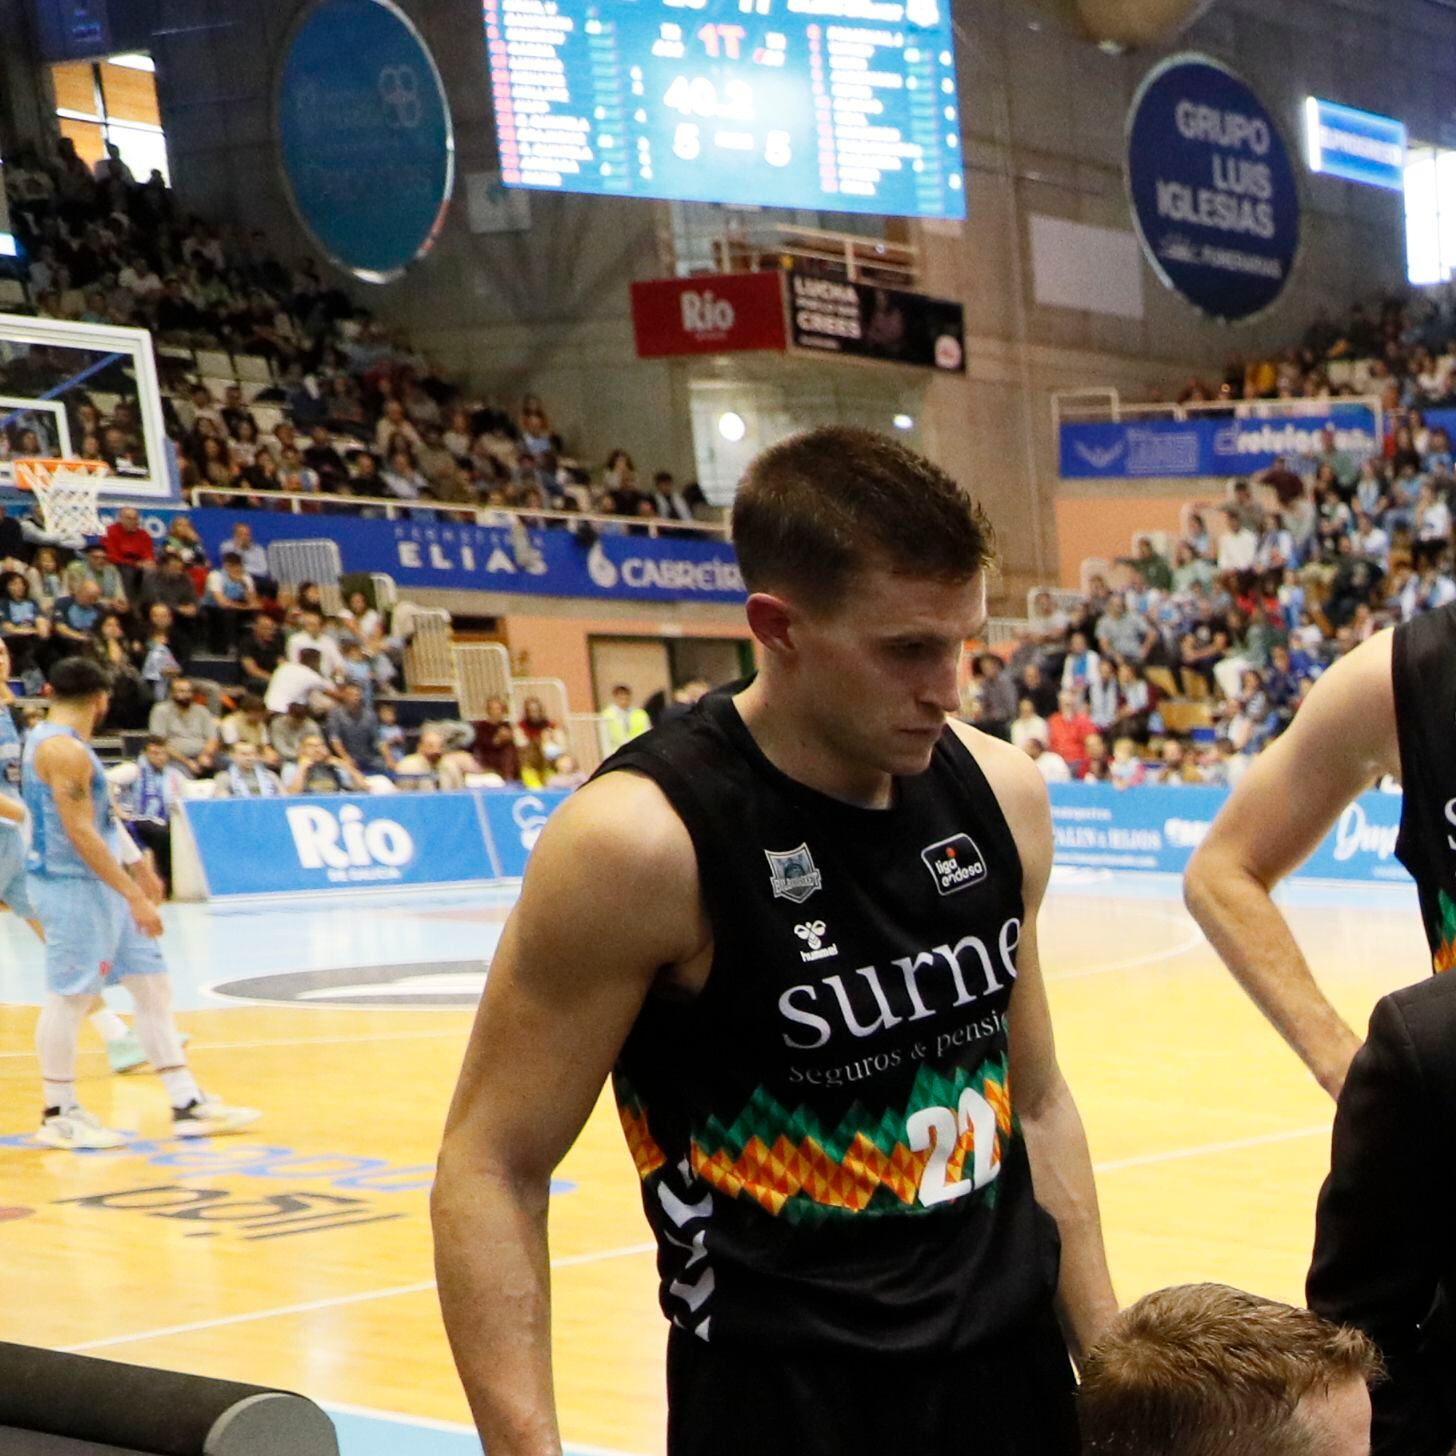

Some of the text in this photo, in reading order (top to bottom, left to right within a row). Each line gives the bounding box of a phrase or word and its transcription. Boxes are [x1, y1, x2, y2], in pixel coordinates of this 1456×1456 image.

[1174, 101, 1271, 155] GRUPO
[1211, 153, 1273, 200] LUIS
[1155, 178, 1276, 239] IGLESIAS
[680, 289, 735, 332] Rio
[621, 557, 748, 593] CABREIR
[286, 803, 415, 870] Rio
[934, 857, 958, 876] liga
[941, 861, 983, 887] endesa
[799, 943, 839, 963] hummel
[778, 917, 1021, 1049] surne
[788, 1009, 1009, 1088] seguros & pensi
